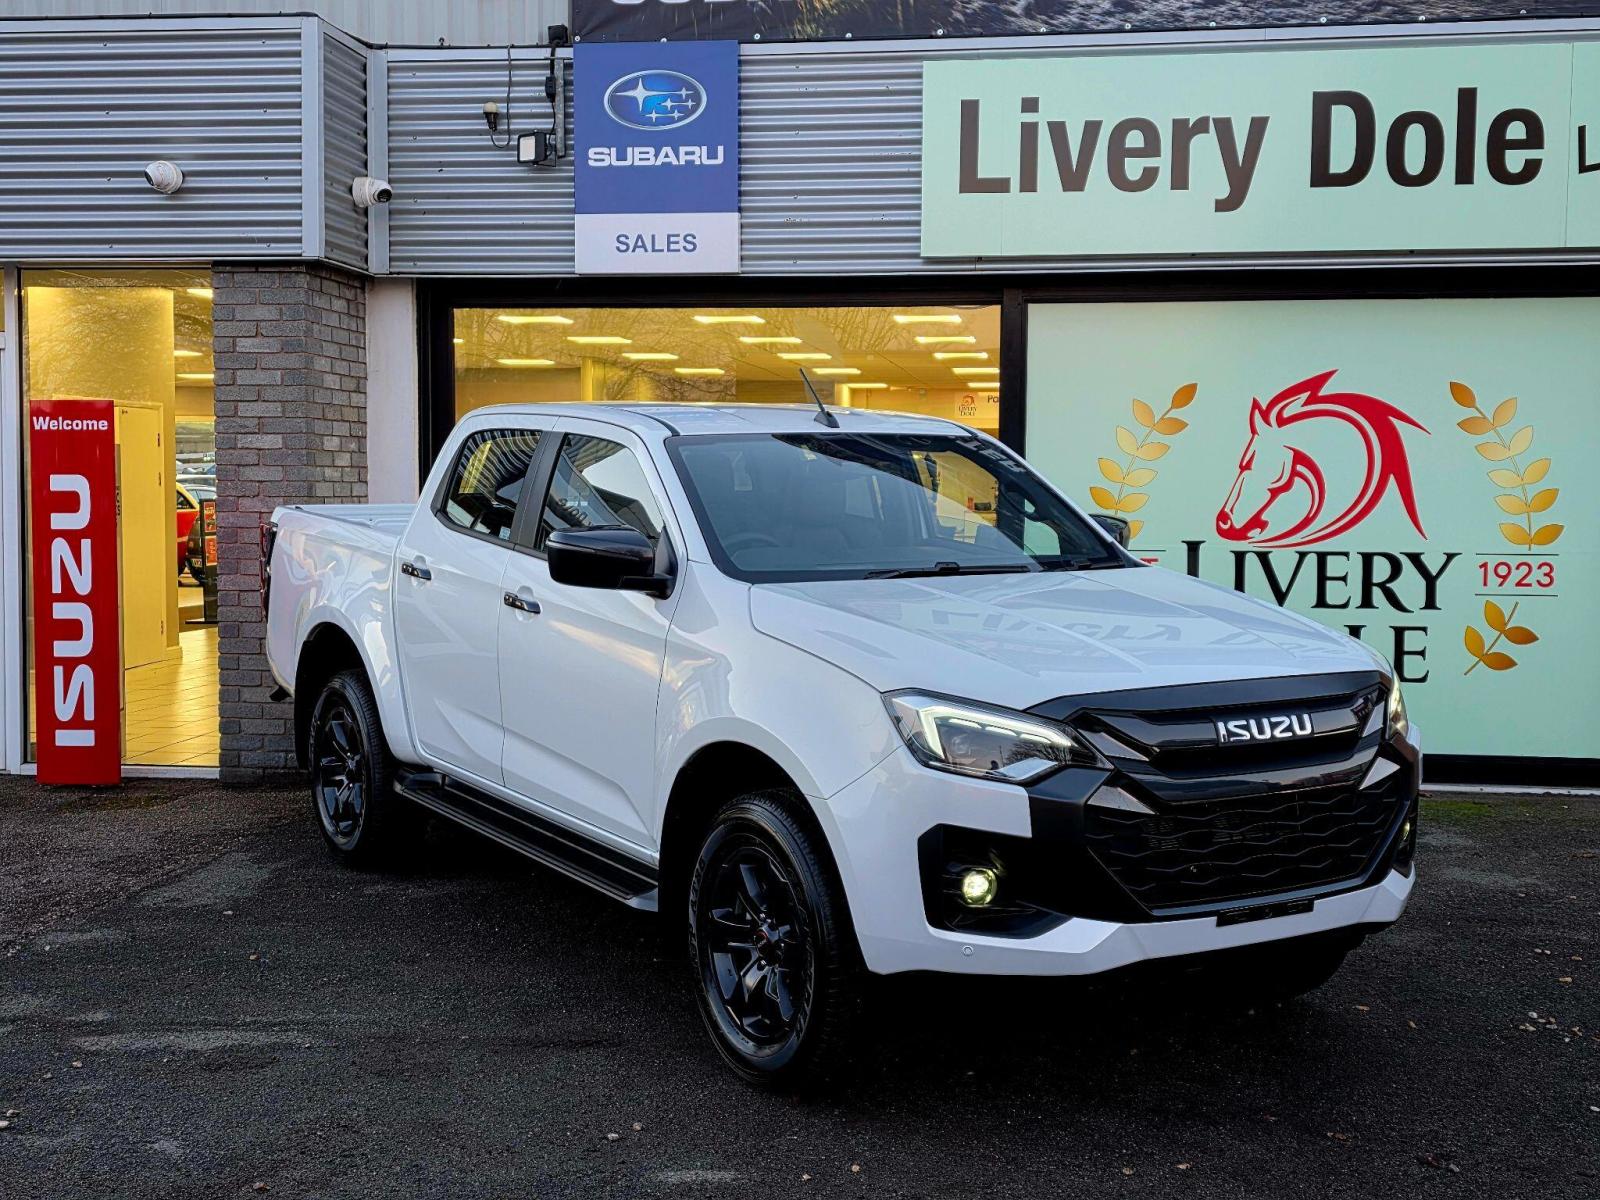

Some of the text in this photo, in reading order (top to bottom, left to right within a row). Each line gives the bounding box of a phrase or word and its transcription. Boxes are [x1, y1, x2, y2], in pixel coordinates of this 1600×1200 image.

[587, 145, 724, 167] SUBARU
[959, 86, 1545, 213] Livery Dole
[615, 233, 698, 253] SALES
[32, 416, 109, 431] Welcome
[1478, 562, 1555, 588] 1923
[49, 474, 95, 747] ISUZU
[1217, 713, 1312, 743] ISUZU
